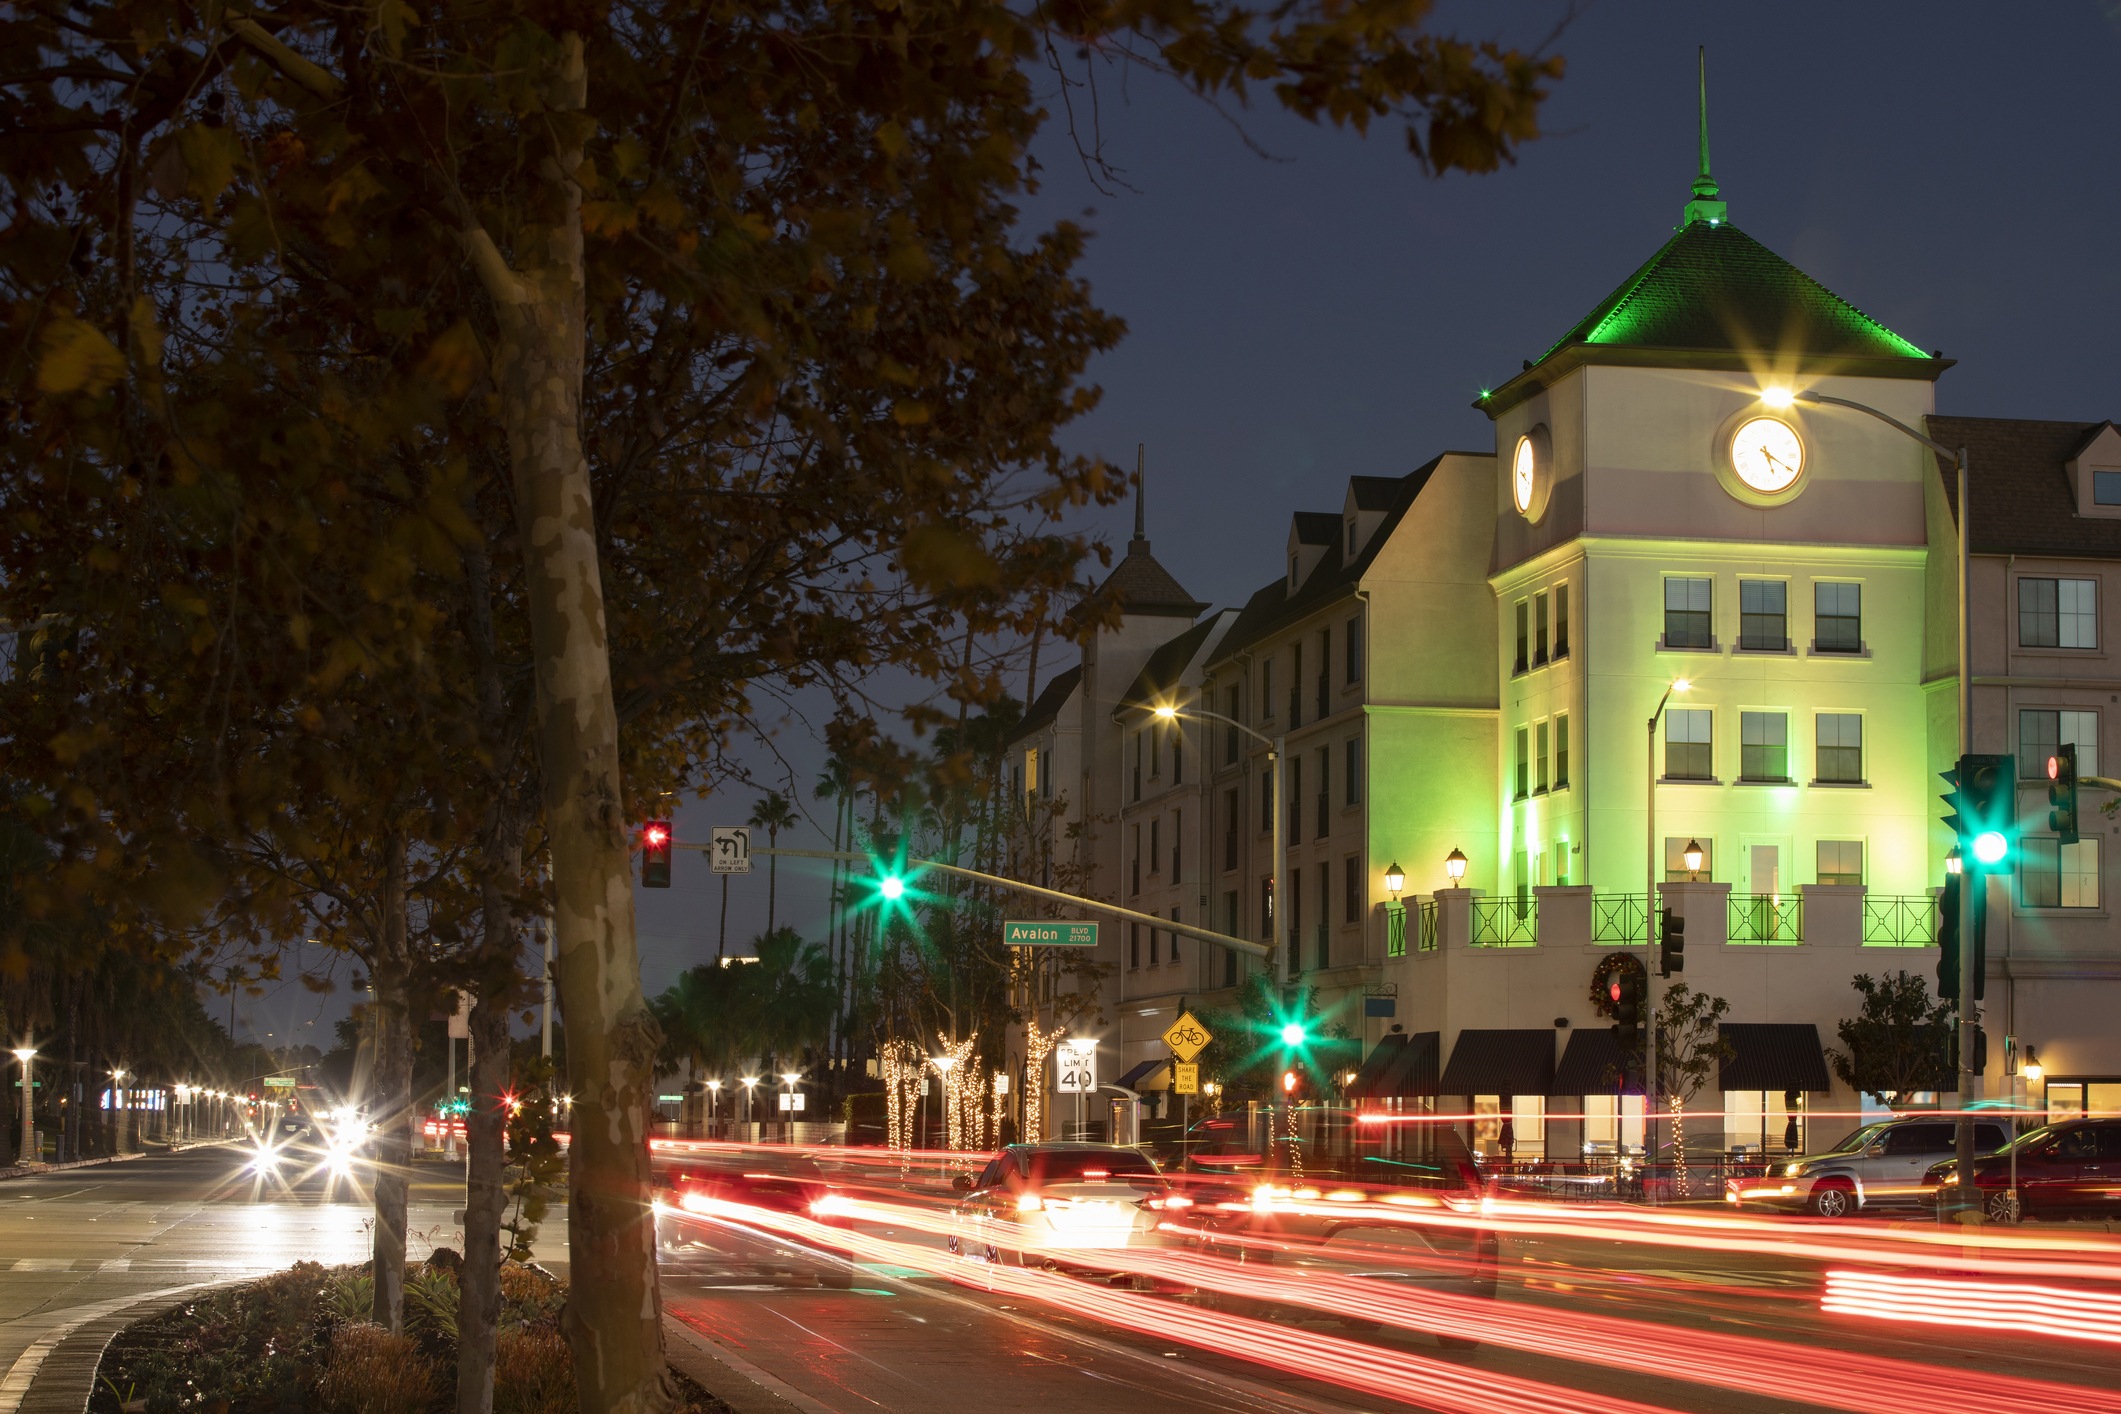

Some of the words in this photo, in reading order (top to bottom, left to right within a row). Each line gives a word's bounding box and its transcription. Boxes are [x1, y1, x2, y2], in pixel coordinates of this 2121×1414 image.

[1011, 927, 1058, 940] Avalon
[1061, 1048, 1093, 1056] PED
[1064, 1059, 1089, 1067] LIMT
[1061, 1070, 1092, 1088] 40
